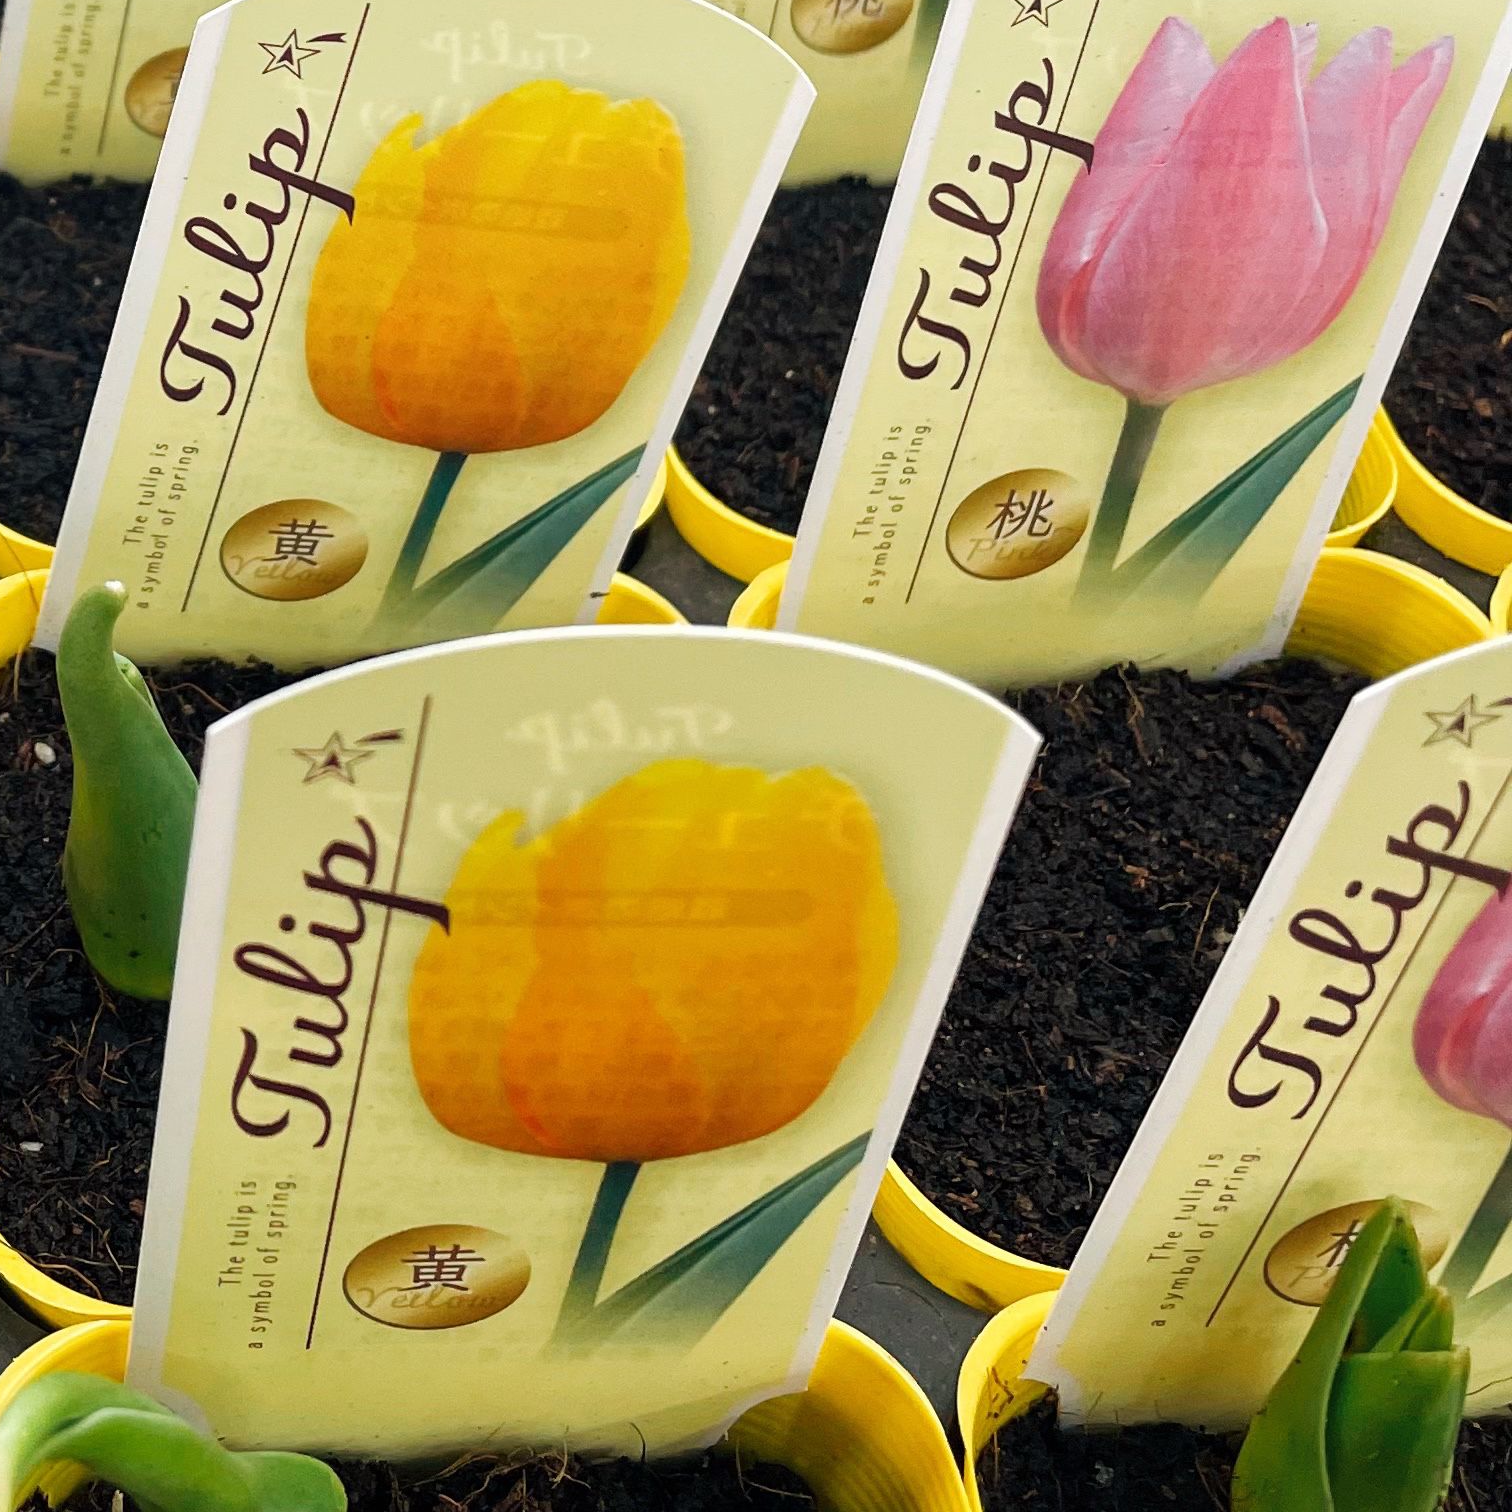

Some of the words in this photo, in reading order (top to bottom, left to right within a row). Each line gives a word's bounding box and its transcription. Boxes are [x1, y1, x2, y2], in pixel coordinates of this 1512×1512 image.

[897, 56, 1095, 391] Tulip
[159, 107, 357, 417] Tulip
[149, 442, 169, 457] is
[882, 425, 903, 441] is
[137, 466, 165, 506] tulip
[868, 450, 898, 495] tulip
[157, 508, 177, 525] of
[852, 504, 878, 538] The
[888, 494, 906, 513] of
[985, 488, 1056, 540] 桃
[122, 515, 149, 545] The
[267, 518, 335, 566] 黄
[140, 534, 169, 593] symbol
[867, 522, 898, 587] symbol
[136, 601, 149, 609] a
[862, 596, 875, 605] a
[1228, 779, 1512, 1122] Tulip
[230, 816, 451, 1149] Tulip
[235, 1181, 257, 1195] is
[1147, 1231, 1183, 1263] The
[1173, 1178, 1214, 1220] tulip
[1198, 1153, 1224, 1168] is
[227, 1205, 258, 1246] tulip
[218, 1256, 245, 1287] The
[256, 1247, 280, 1264] of
[400, 1243, 486, 1292] 黄
[1151, 1319, 1167, 1327] a
[1160, 1248, 1205, 1310] symbol
[1197, 1223, 1219, 1239] of
[248, 1274, 275, 1332] symbol
